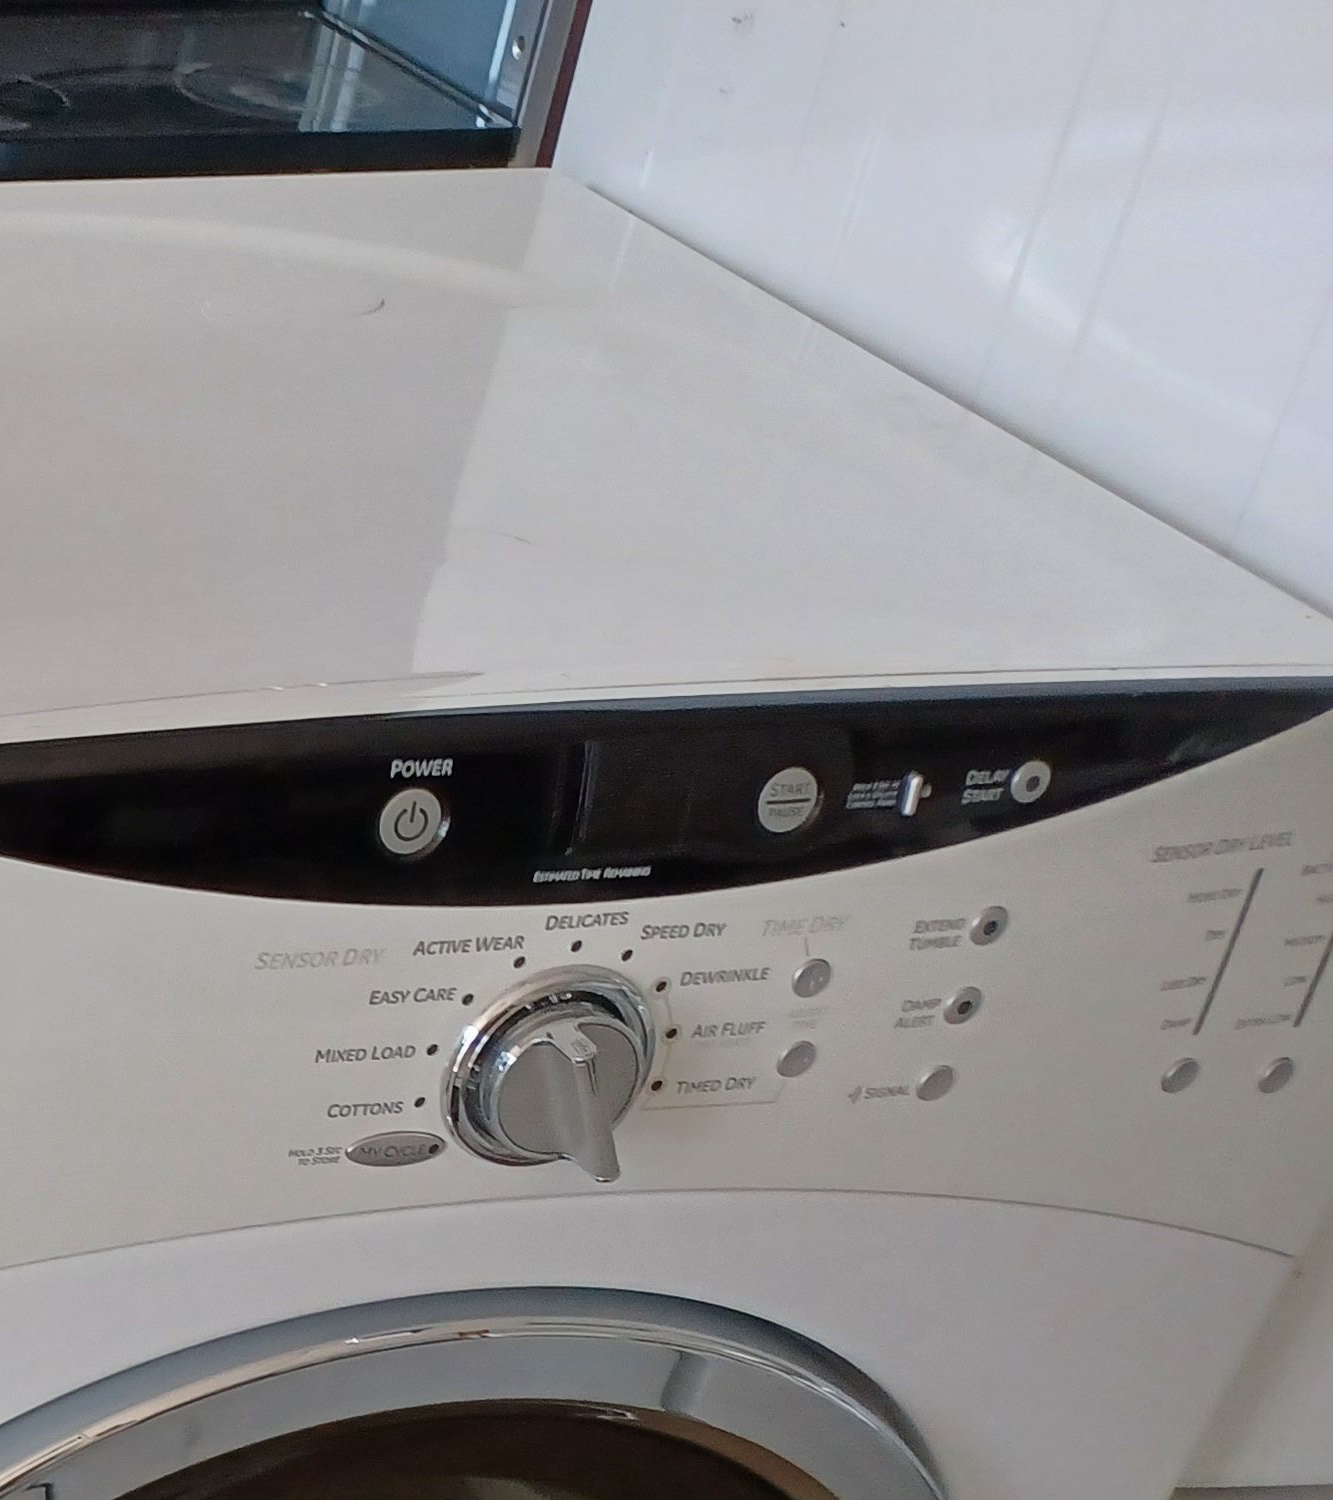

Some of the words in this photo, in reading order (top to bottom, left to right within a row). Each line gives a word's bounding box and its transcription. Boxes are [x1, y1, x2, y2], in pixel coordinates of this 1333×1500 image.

[390, 759, 453, 778] POWER
[771, 782, 811, 796] START
[545, 911, 629, 931] DELICATES
[641, 924, 687, 941] SPEED
[692, 922, 727, 939] DRY
[413, 937, 472, 957] ACTIVE
[475, 935, 525, 953] WEAR
[255, 952, 339, 970] SENSOR
[343, 948, 387, 966] DRY
[680, 967, 770, 986] DEWRINKLE
[370, 988, 408, 1006] EASY
[413, 986, 457, 1004] CARE
[691, 1024, 716, 1039] AIR
[721, 1022, 767, 1036] FLUFF
[314, 1048, 364, 1064] MIXED
[369, 1044, 416, 1061] LOAD
[677, 1079, 721, 1094] TIMED
[725, 1077, 757, 1091] DRY
[328, 1101, 404, 1118] COTTONS
